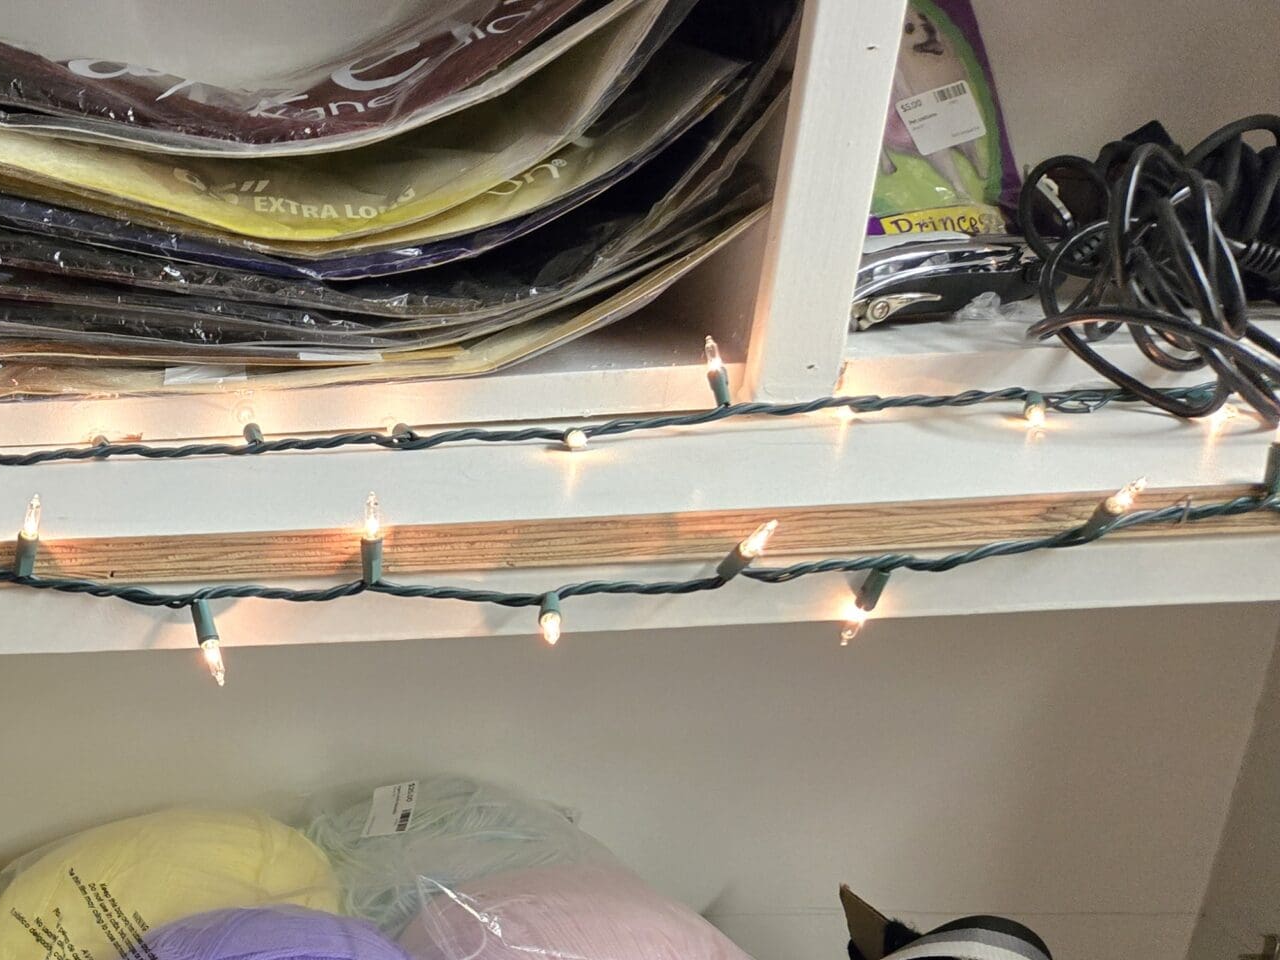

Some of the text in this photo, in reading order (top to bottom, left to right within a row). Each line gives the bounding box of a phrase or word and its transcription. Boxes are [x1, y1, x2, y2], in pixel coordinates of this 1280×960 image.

[254, 194, 339, 220] EXTRA
[87, 880, 98, 892] Do
[97, 881, 113, 899] Keep
[92, 890, 103, 903] not
[82, 894, 97, 911] may
[90, 907, 105, 926] cling
